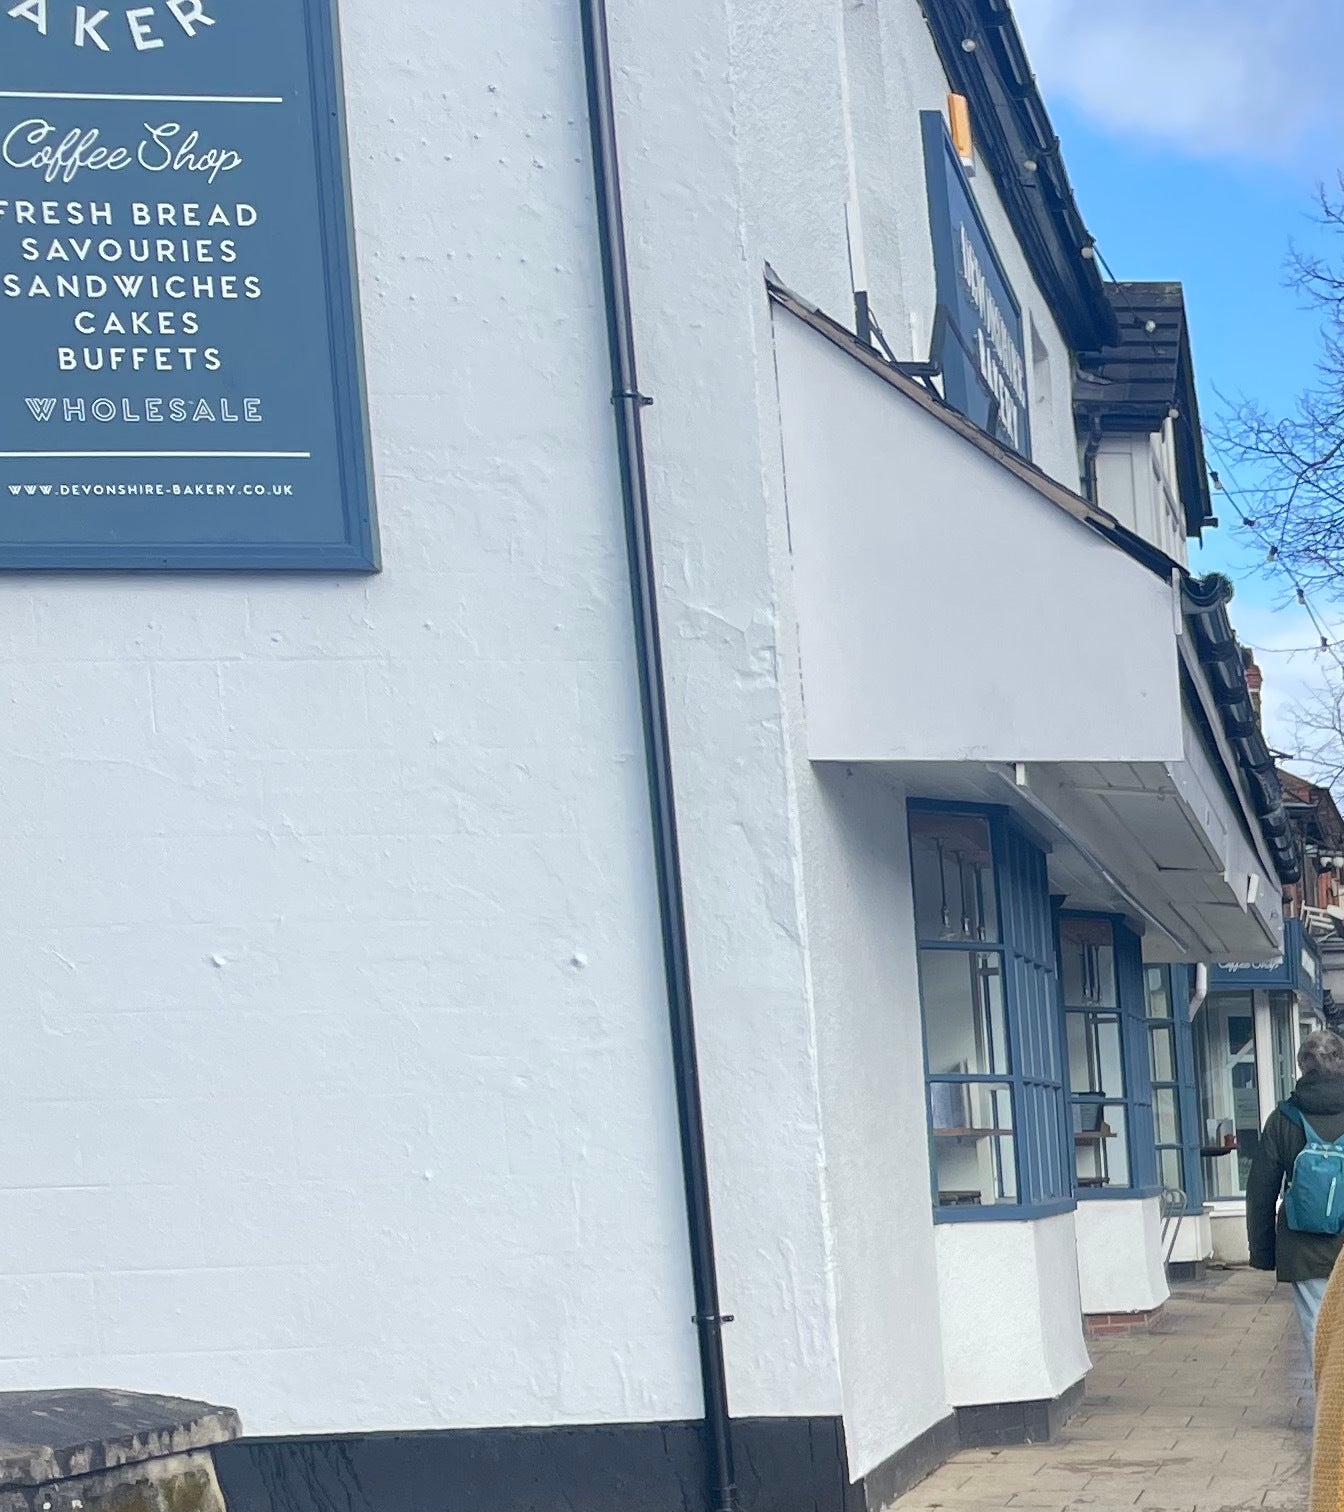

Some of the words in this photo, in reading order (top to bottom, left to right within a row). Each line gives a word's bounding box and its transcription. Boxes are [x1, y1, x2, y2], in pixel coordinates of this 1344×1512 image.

[2, 118, 132, 183] Coffee
[137, 122, 242, 184] Shop
[131, 202, 258, 227] BREAD
[21, 237, 237, 263] SAVOURIES
[2, 273, 262, 299] SANDWICHES
[73, 310, 200, 335] CAKES
[58, 347, 222, 371] BUFFETS
[25, 397, 263, 423] WHOLESALE
[8, 483, 294, 497] WWW.DEVONSHIRE-BAKERY.CO.UK
